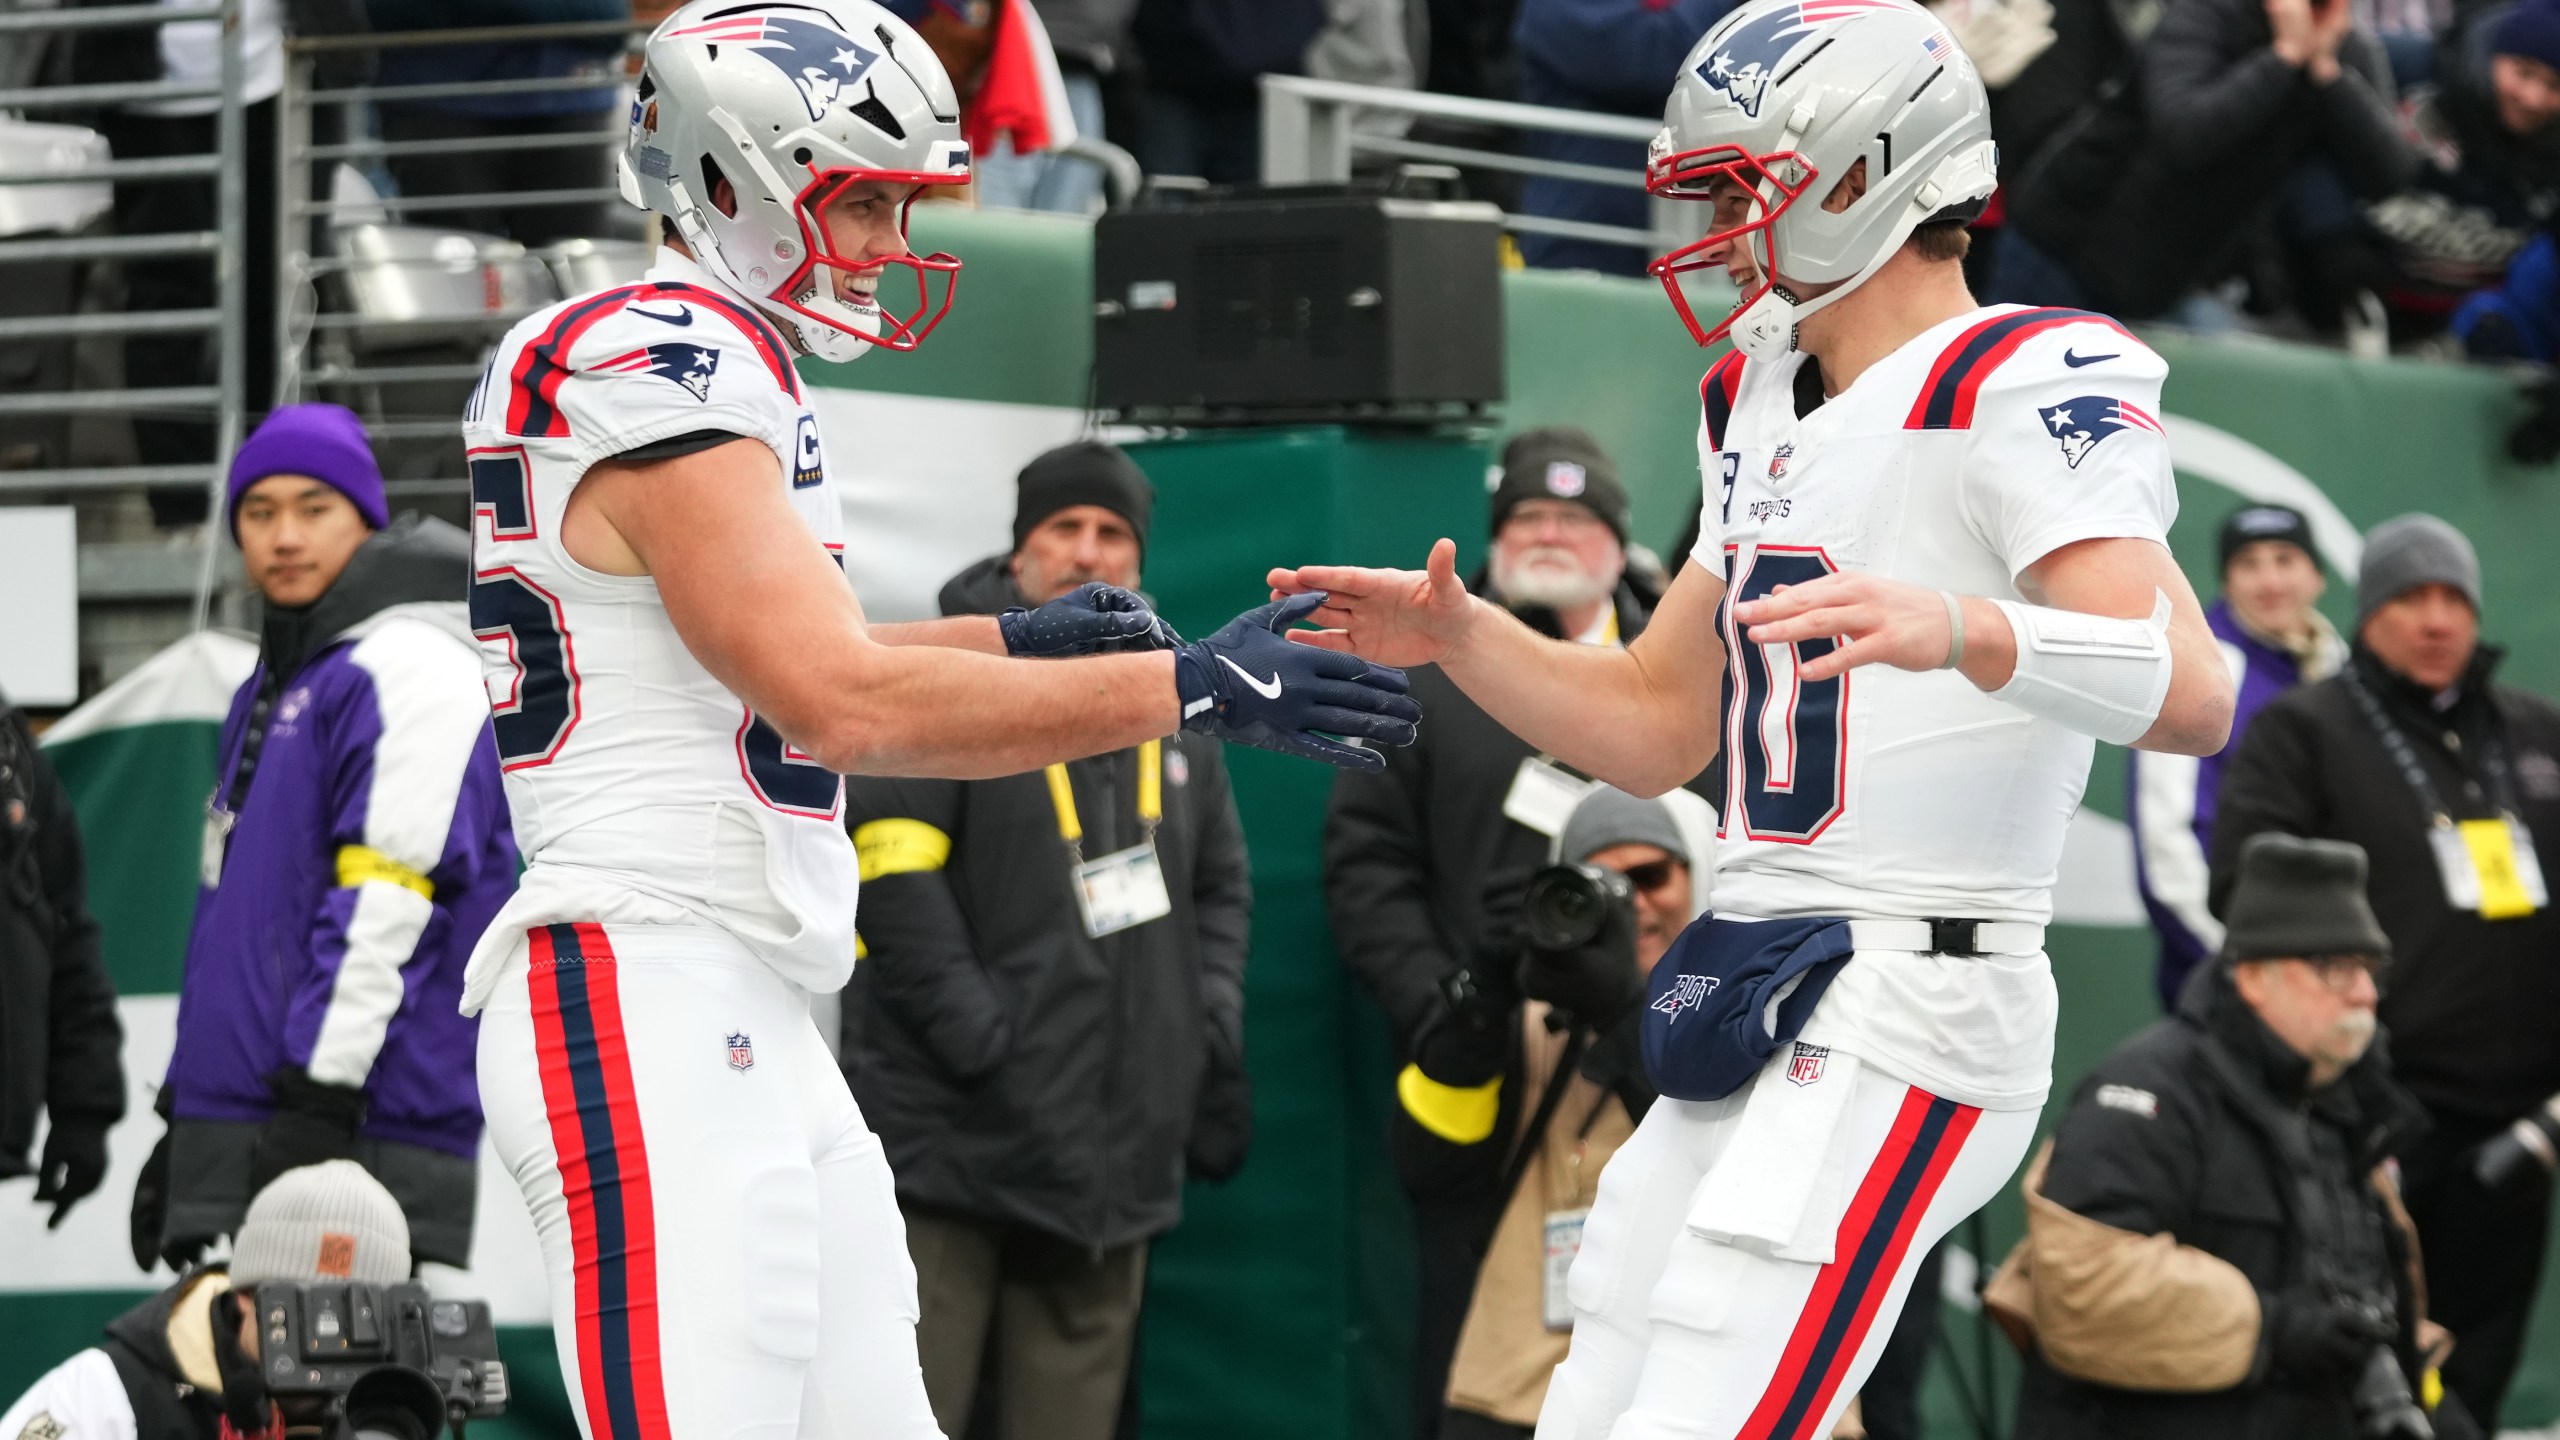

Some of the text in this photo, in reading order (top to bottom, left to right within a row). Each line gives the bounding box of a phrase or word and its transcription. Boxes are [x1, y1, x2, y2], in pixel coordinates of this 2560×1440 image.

[798, 420, 820, 470] C
[730, 1048, 753, 1066] NFL
[1789, 1057, 1820, 1081] NFL
